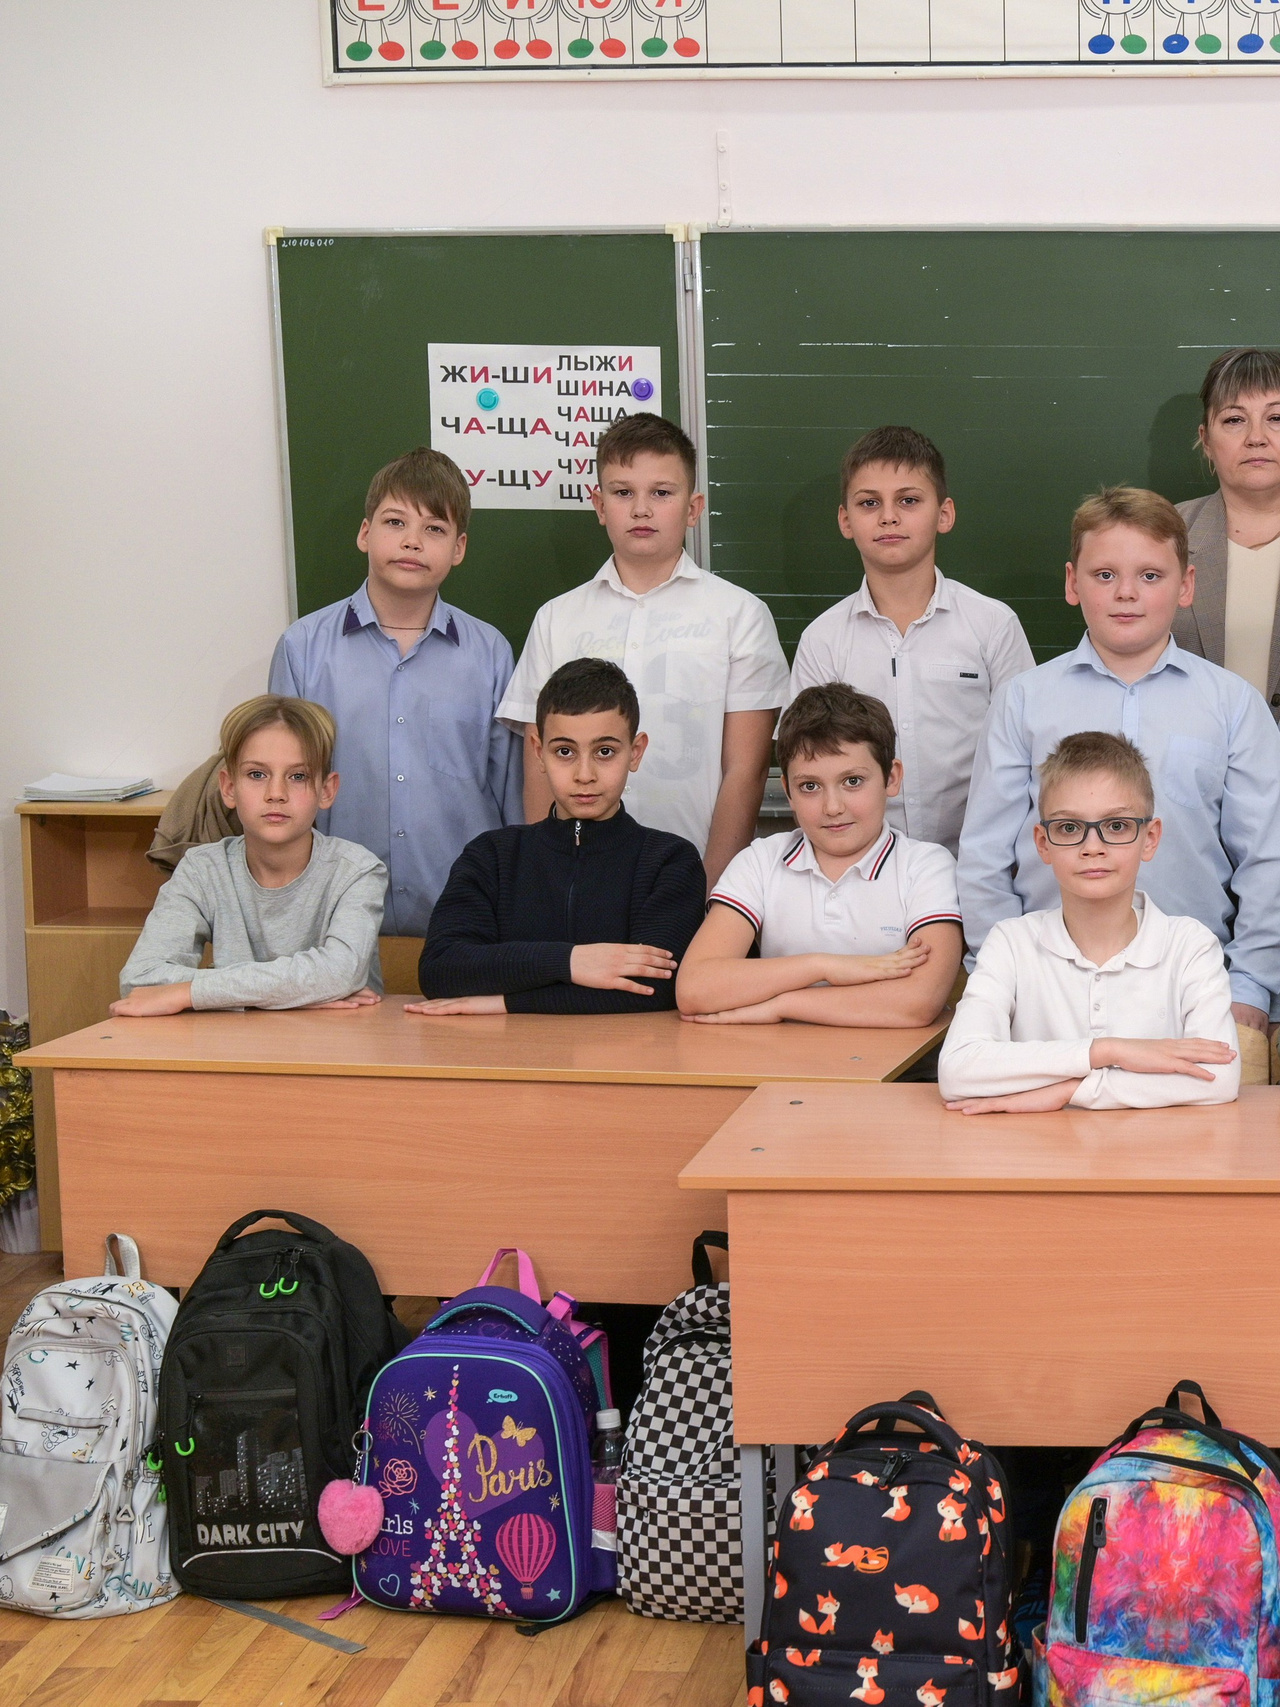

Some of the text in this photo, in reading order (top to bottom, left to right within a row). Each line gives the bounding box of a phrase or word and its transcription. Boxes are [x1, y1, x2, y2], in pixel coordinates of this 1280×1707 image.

[556, 355, 633, 372] ЛЫЖИ
[440, 365, 552, 384] ЖИ-ШИ
[557, 380, 632, 397] ШИНА
[440, 416, 552, 438] ЧА-ЩА
[461, 469, 553, 490] У-ЩУ
[467, 1432, 553, 1503] Paris
[196, 1520, 305, 1546] DARK CITY
[380, 1514, 414, 1535] rls
